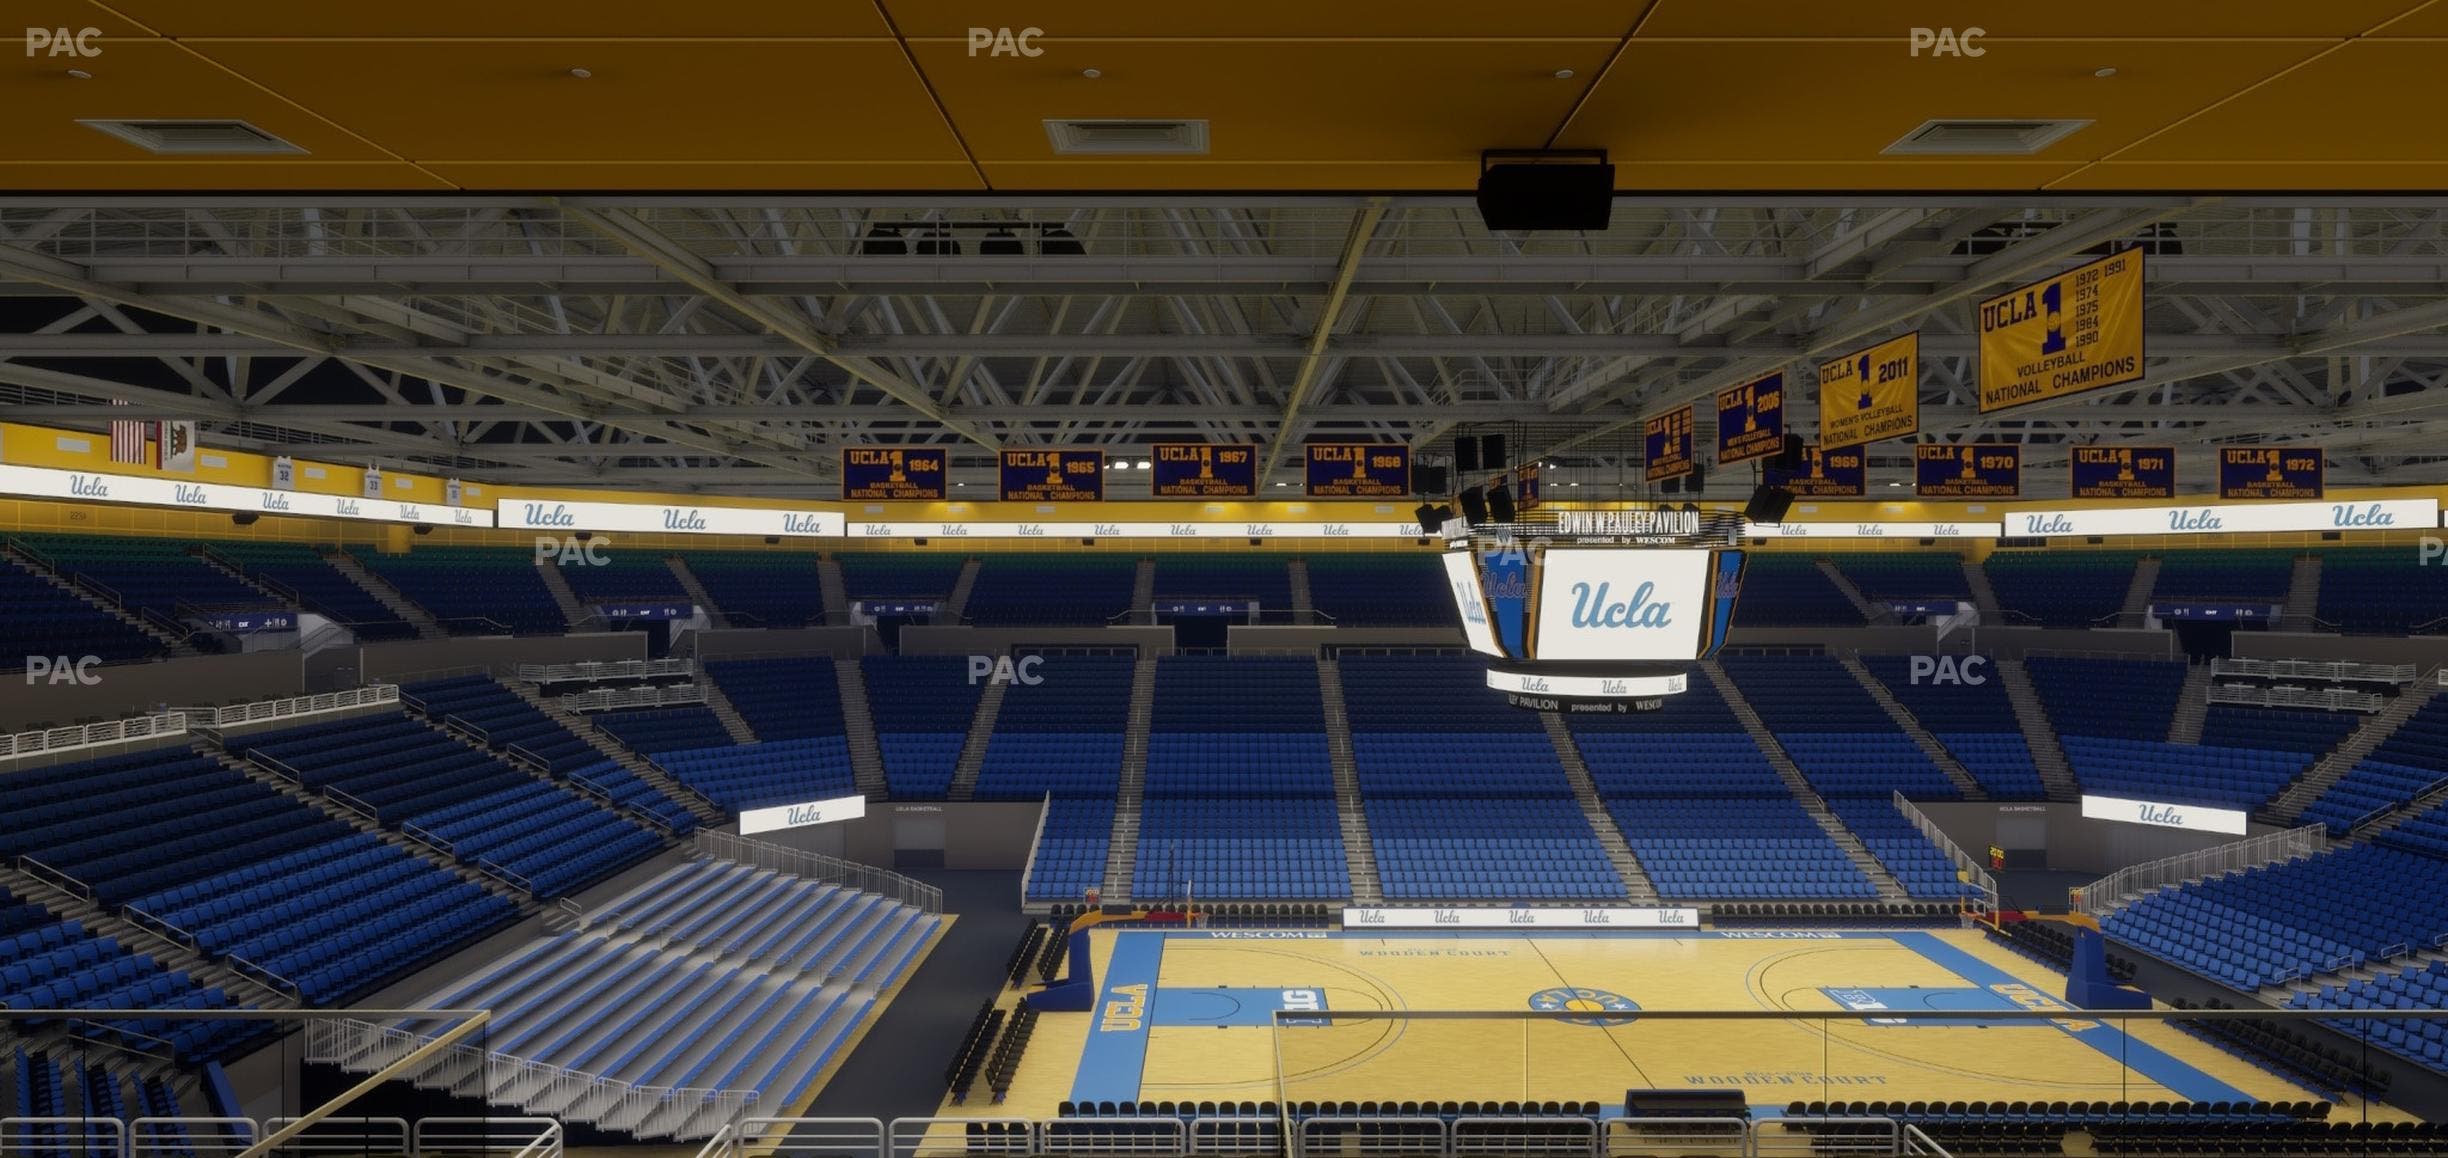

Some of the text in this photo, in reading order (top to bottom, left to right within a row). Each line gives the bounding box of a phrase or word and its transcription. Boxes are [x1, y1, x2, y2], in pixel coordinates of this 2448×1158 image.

[2104, 259, 2126, 277] 1991
[1983, 291, 2037, 333] UCLA
[1822, 360, 1853, 384] UCLA
[1879, 356, 1908, 384] 2011
[2017, 352, 2086, 378] VOLLEYBALL
[1986, 356, 2135, 404] NATIONAL CHAMPIONS
[1720, 390, 1743, 411] UCLA
[1861, 404, 1903, 421] VOLLEYBALL
[1824, 415, 1912, 445] NATIONAL CHAMPIONS
[851, 450, 889, 464] UCLA
[909, 459, 939, 471] 1964
[1007, 453, 1046, 467] UCLA
[1066, 462, 1095, 474] 1965
[1160, 447, 1198, 461] UCLA
[1219, 451, 1247, 463] 1967
[1313, 447, 1352, 461] UCLA
[1919, 448, 1954, 460] UCLA
[1981, 456, 2014, 468] 1970
[2078, 449, 2117, 464] UCLA
[2137, 458, 2164, 470] 1971
[2227, 449, 2266, 464] UCLA
[2286, 458, 2315, 471] 1972
[70, 474, 108, 497] Ucla
[175, 484, 207, 504] Ucla
[262, 492, 289, 510] Ucla
[337, 498, 359, 516] Ucla
[400, 504, 420, 520] Ucla
[851, 489, 938, 498] NATIONAL CHAMPIONS
[1008, 491, 1095, 500] NATIONAL CHAMPIONS
[1161, 485, 1247, 494] NATIONAL CHAMPIONS
[1314, 485, 1401, 494] NATIONAL CHAMPIONS
[1812, 485, 1857, 494] CHAMPIONS
[1922, 485, 2014, 495] NATIONAL CHAMPIONS
[2079, 488, 2167, 497] NATIONAL CHAMPIONS
[2228, 488, 2315, 497] NATIONAL CHAMPIONS
[525, 503, 821, 533] Ucla Ucla Ucla
[1558, 511, 1699, 534] EDWIN W PAULEY PAVILION
[2027, 503, 2394, 534] Ucla Ucla Ucla
[865, 524, 891, 536] Ucla
[942, 524, 967, 536] Ucla
[1018, 524, 1044, 536] Ucla
[1094, 524, 1120, 536] Ucla
[1171, 524, 1197, 536] Ucla
[1247, 524, 1273, 536] Ucla
[1323, 524, 1349, 536] Ucla
[1781, 524, 1959, 536] Ucla Ucla Ucla
[1577, 536, 1675, 545] presented by WESCOM
[1571, 581, 1672, 629] Ucla
[1521, 676, 1549, 692] Ucla
[1601, 679, 1626, 694] Ucla
[1520, 696, 1558, 710] PAVILION
[1571, 702, 1611, 712] presented
[1617, 702, 1627, 712] by
[787, 805, 821, 825] Ucla
[2139, 804, 2183, 825] Ucla
[1359, 909, 1684, 924] Ucla Ucla Ucla Ucla Ucla
[1100, 984, 1148, 1031] UCLA
[1684, 1075, 1887, 1085] WOODEN COURT
